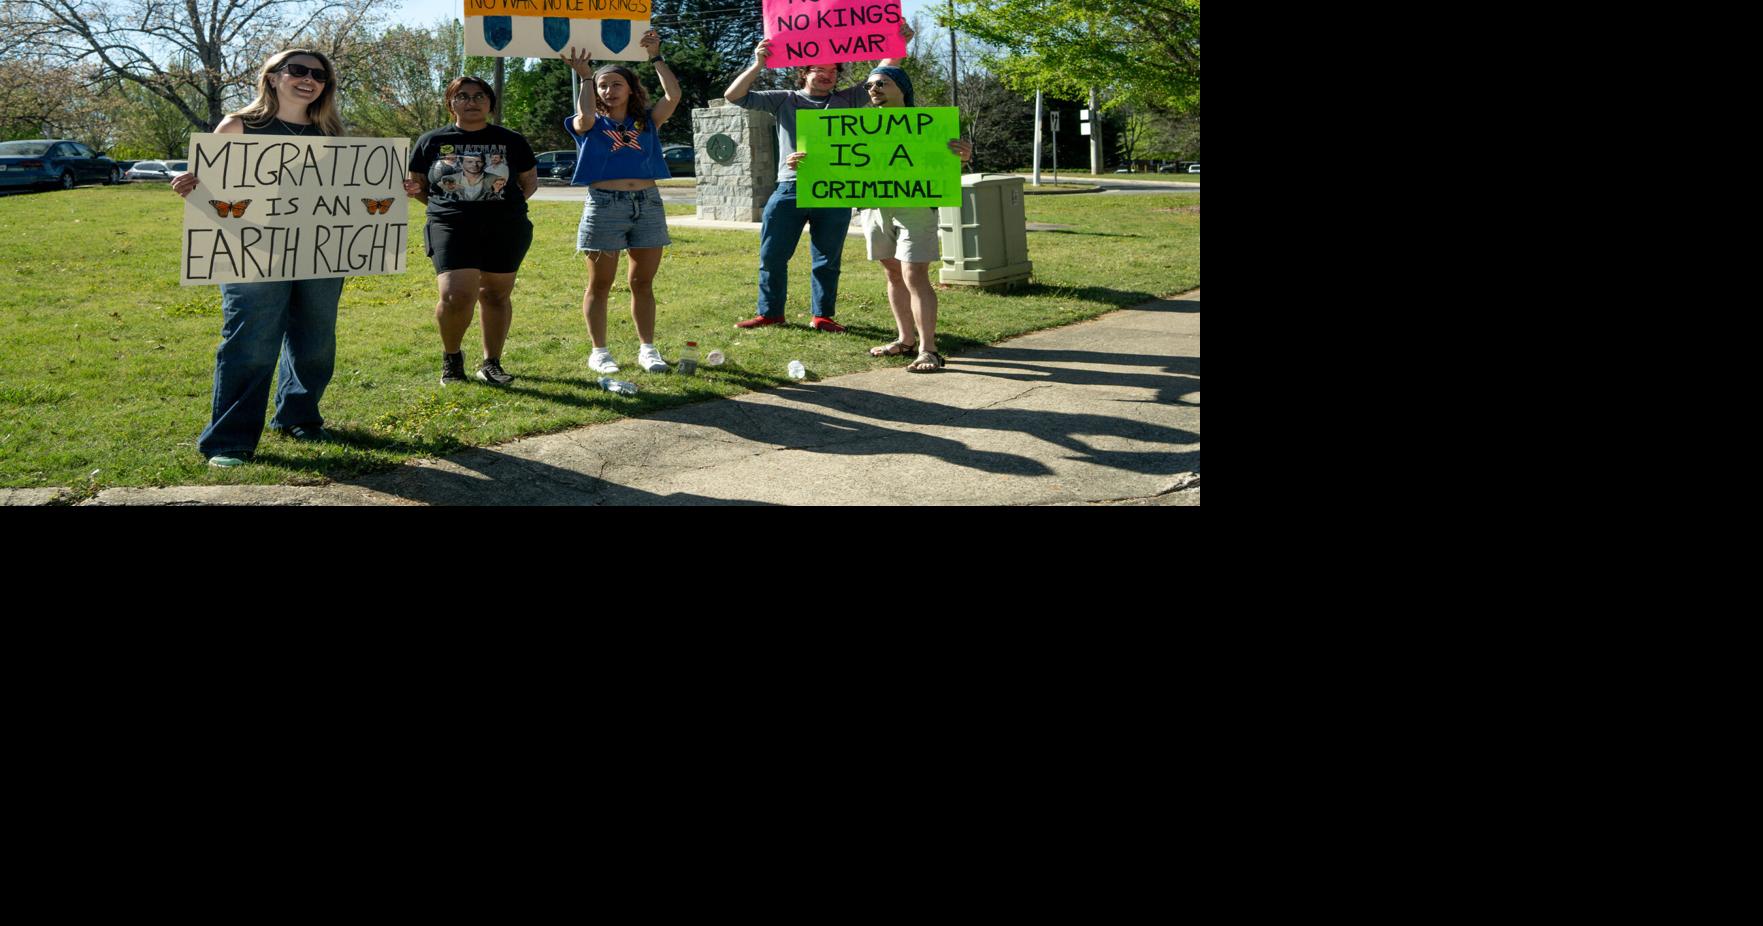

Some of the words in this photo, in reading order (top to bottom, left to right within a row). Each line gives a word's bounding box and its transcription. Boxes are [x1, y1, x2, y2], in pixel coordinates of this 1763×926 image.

[609, 0, 648, 13] KINGS
[777, 14, 810, 31] NO
[817, 3, 901, 29] KINGS
[786, 41, 820, 60] NO
[829, 34, 886, 54] WAR
[819, 113, 933, 137] TRUMP
[193, 141, 408, 190] MIGRATION
[830, 143, 871, 167] IS
[888, 144, 914, 167] A
[812, 180, 942, 199] CRIMINAL
[265, 197, 299, 216] IS
[312, 195, 351, 216] AN
[186, 226, 300, 280] EARTH
[314, 223, 408, 275] RIGHT
